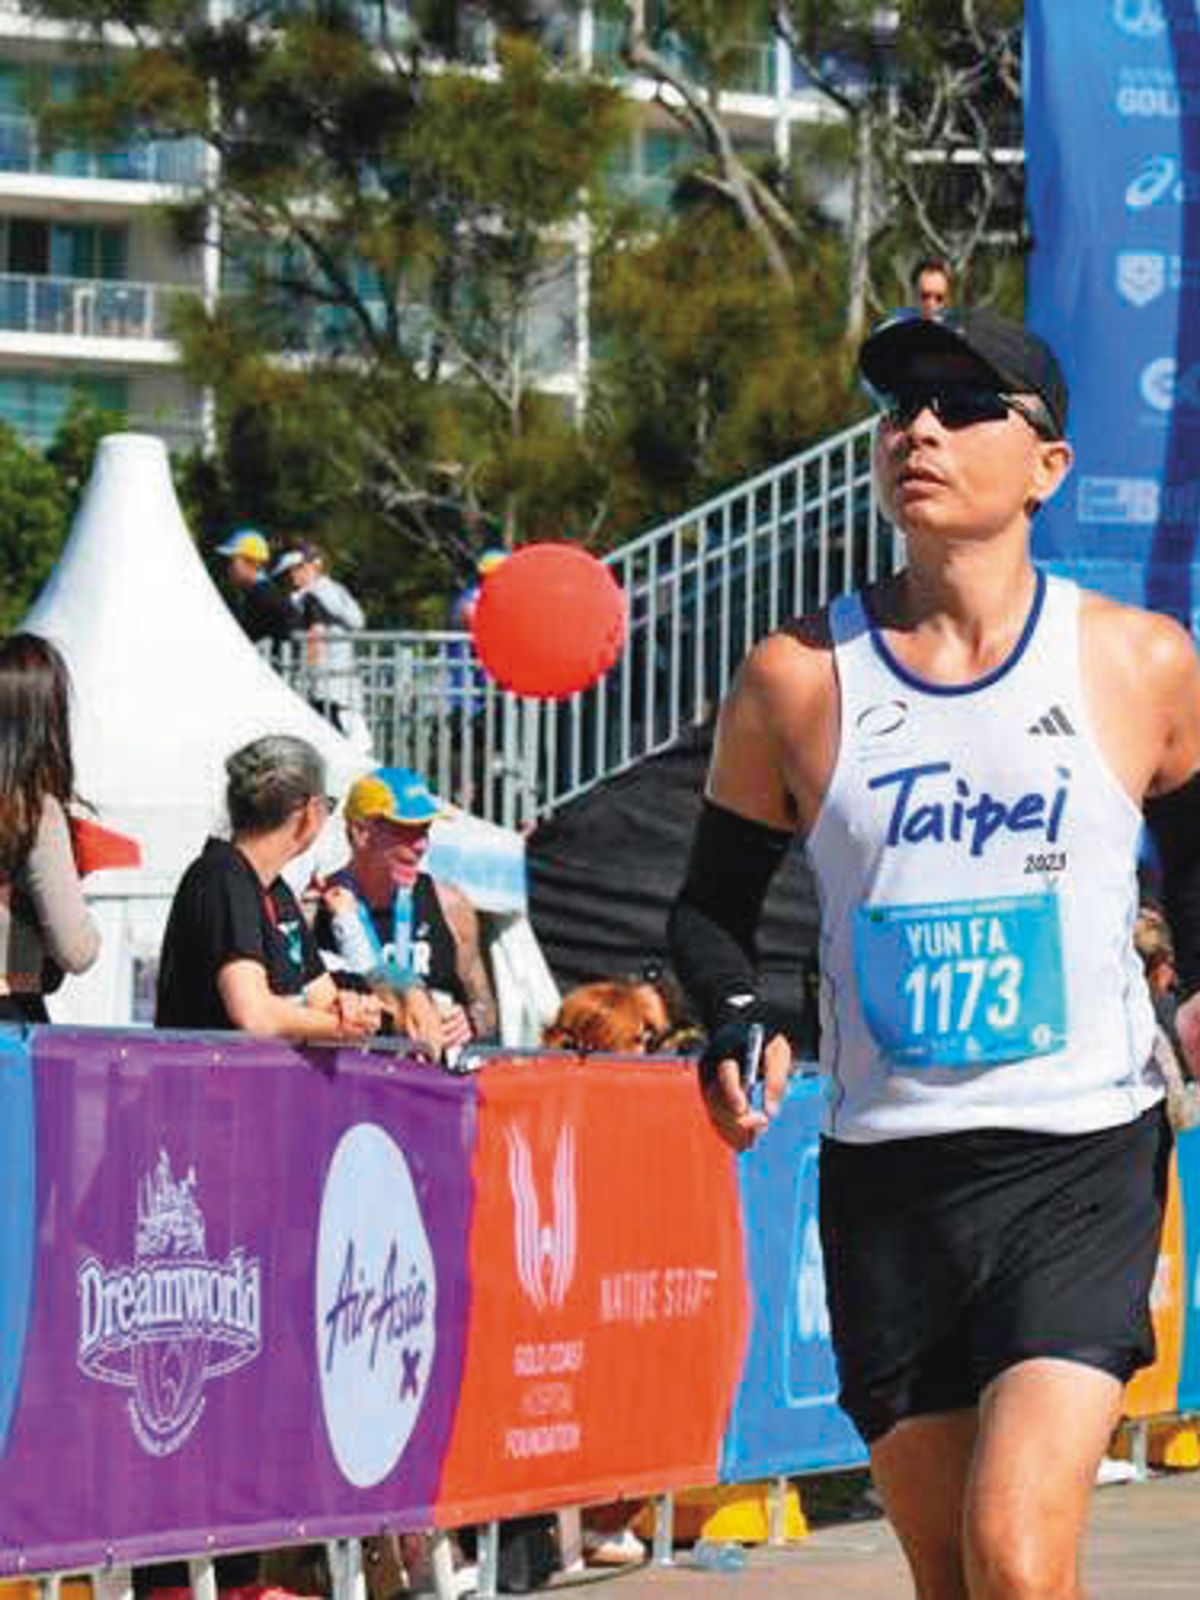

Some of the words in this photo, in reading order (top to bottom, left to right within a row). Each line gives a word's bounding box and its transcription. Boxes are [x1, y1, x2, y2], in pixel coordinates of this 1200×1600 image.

[867, 760, 1072, 858] Taipei
[904, 920, 964, 959] YUN
[968, 916, 1009, 955] FA
[904, 953, 1024, 1035] 1173
[78, 1250, 261, 1341] Dreamworld
